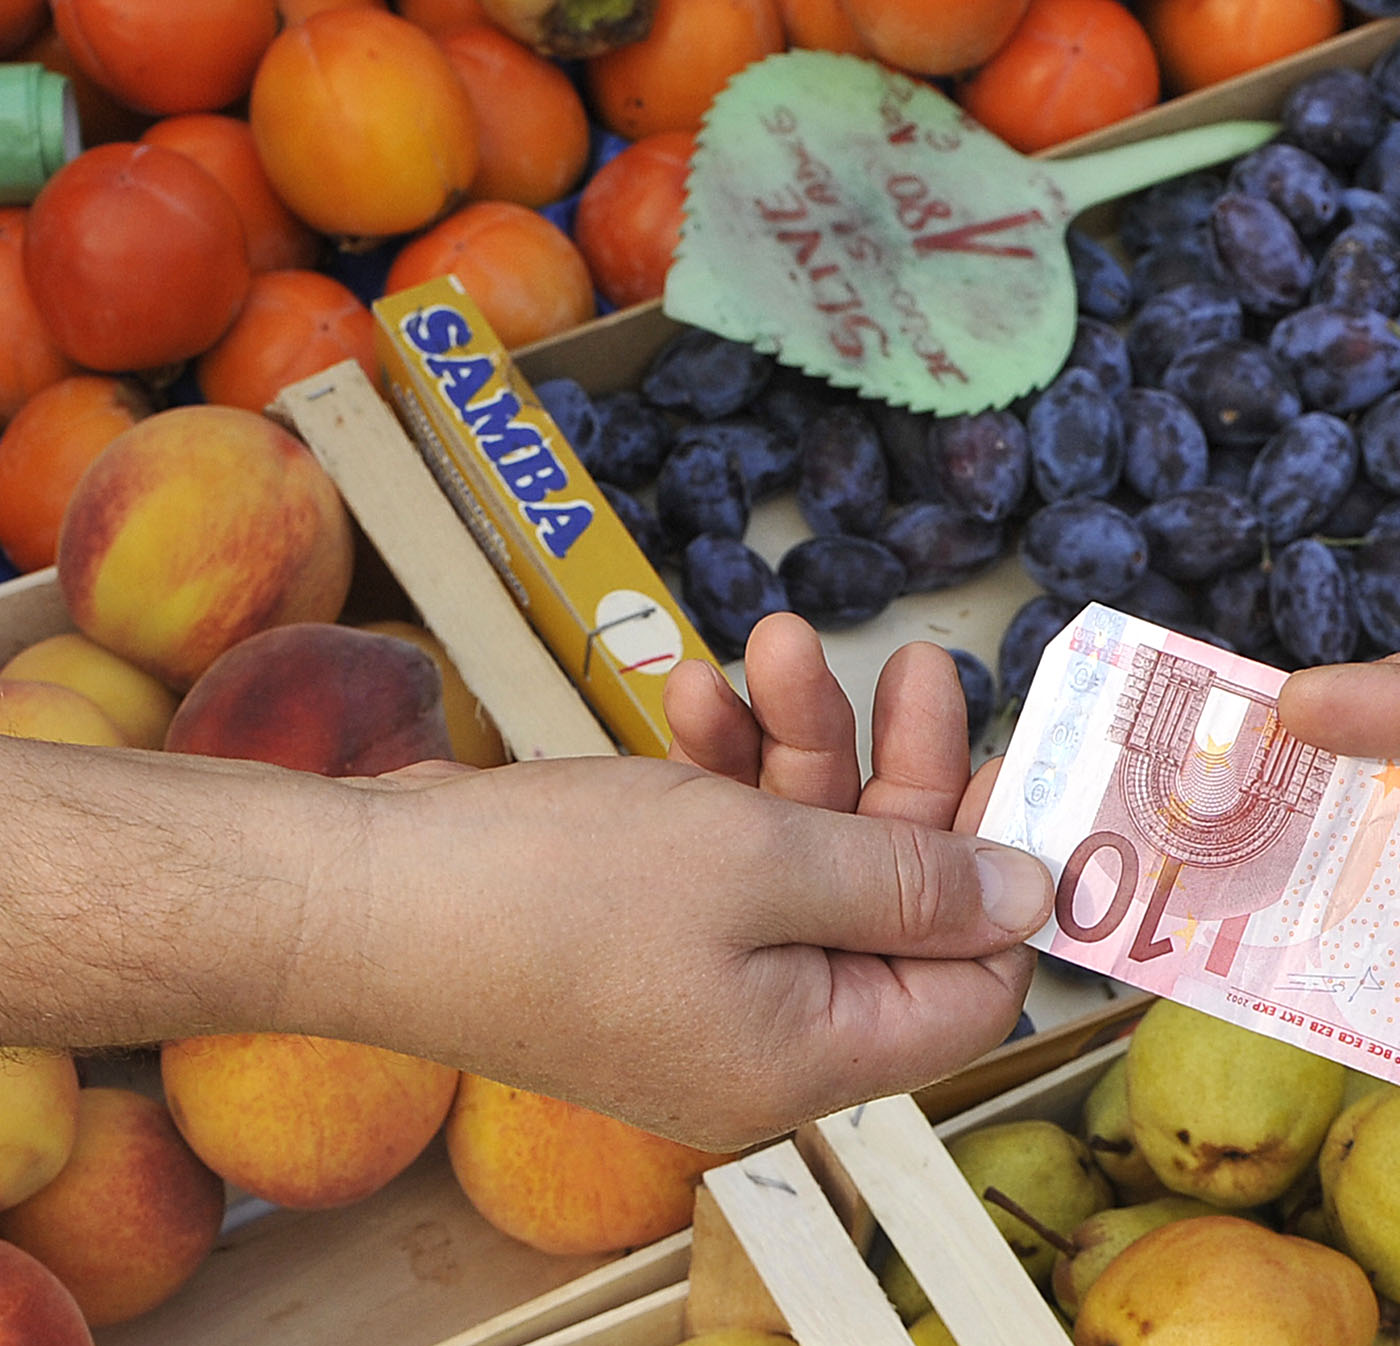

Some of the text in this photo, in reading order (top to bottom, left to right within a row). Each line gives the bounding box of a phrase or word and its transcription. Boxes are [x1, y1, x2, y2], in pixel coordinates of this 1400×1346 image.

[755, 195, 890, 361] SLIVE
[402, 304, 594, 558] SAMBA
[1055, 830, 1174, 963] 10
[1251, 1000, 1276, 1016] EKP
[1278, 1010, 1304, 1027] EKT
[1308, 1020, 1334, 1037] EZB
[1337, 1030, 1363, 1048] ECB
[1367, 1042, 1393, 1059] BCE
